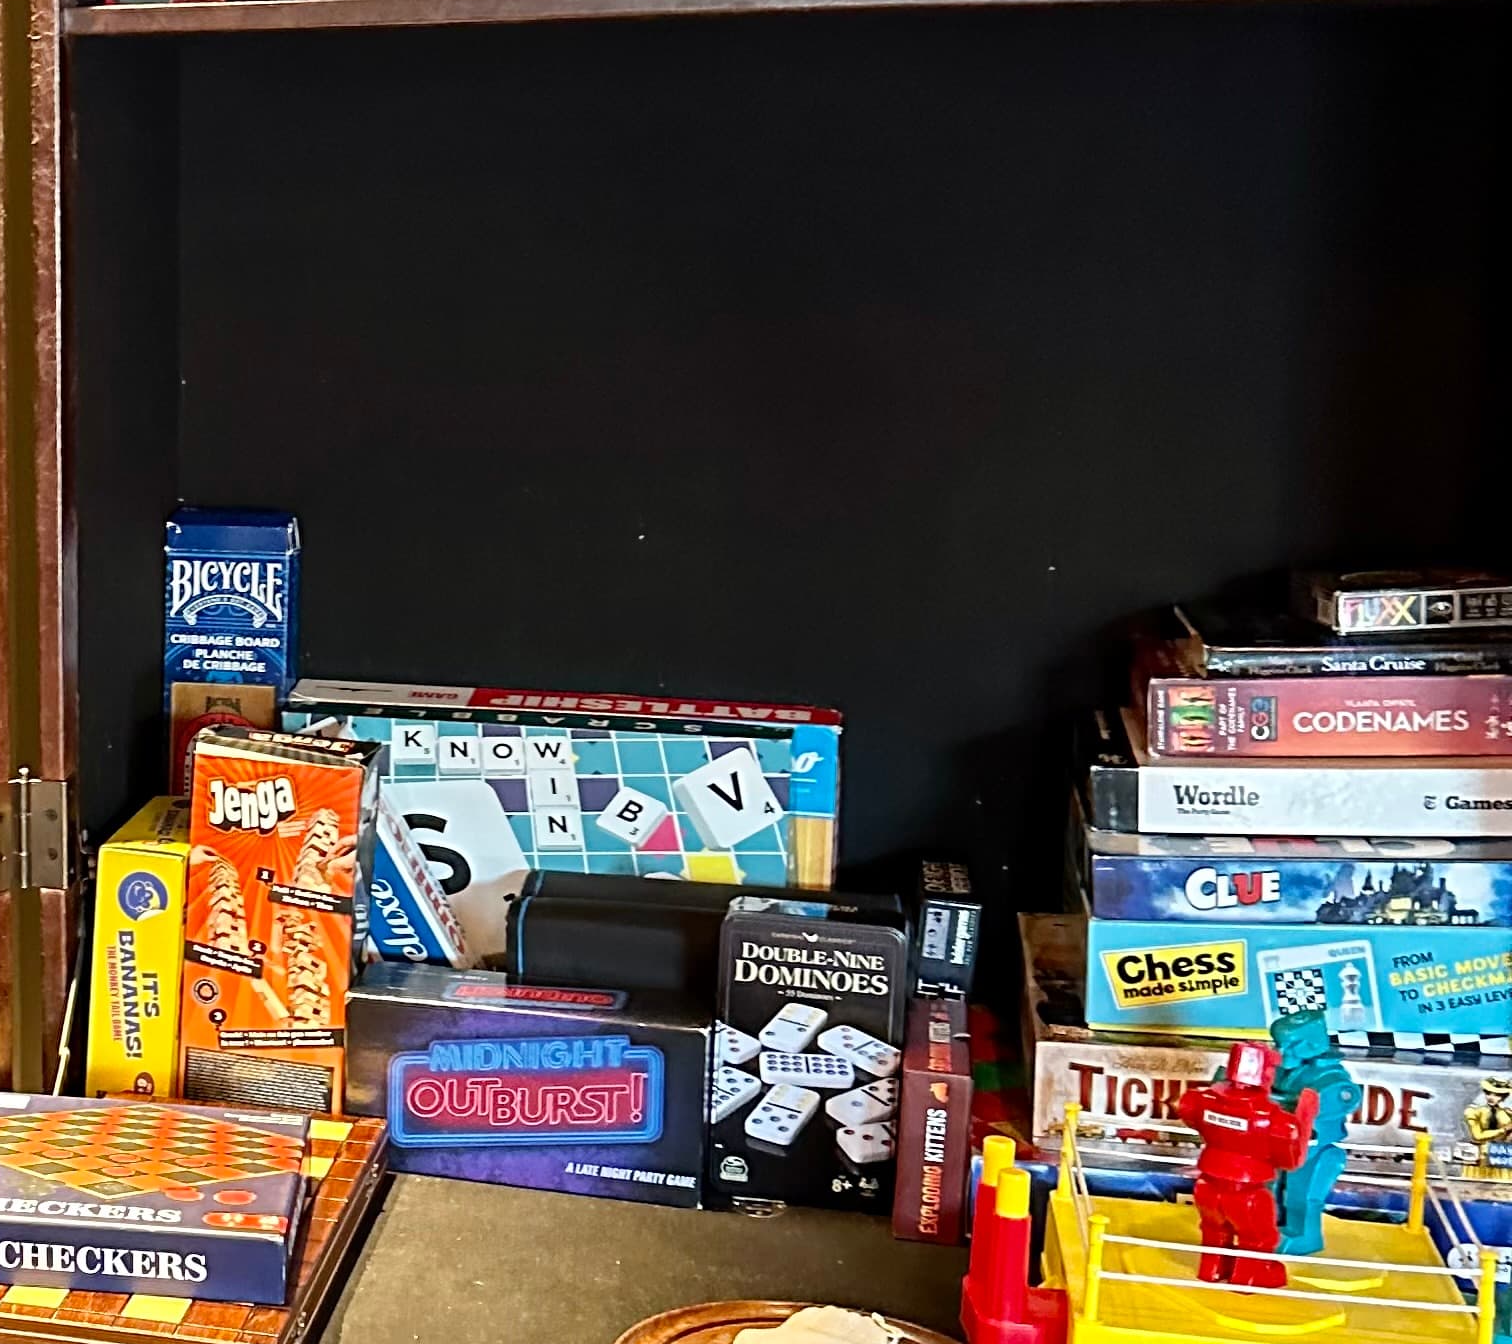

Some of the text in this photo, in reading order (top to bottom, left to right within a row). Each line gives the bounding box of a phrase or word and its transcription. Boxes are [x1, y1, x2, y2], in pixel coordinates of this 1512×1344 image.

[170, 559, 283, 623] BICYCLE
[1341, 595, 1420, 627] FLUXX
[170, 633, 281, 648] CRIBBAGE BOARD
[194, 648, 255, 661] PLANCHE
[183, 659, 267, 674] DE CRIBBAGE
[1320, 656, 1368, 673] Santa
[1368, 655, 1426, 673] Cruise
[362, 706, 702, 733] SCRABBLE
[489, 693, 814, 723] BATTLESHIP
[1292, 709, 1471, 733] CODENAMES
[247, 731, 356, 754] Jenga
[208, 776, 296, 832] Jenga
[1173, 785, 1260, 807] Wordle
[1445, 795, 1512, 810] Games
[1186, 866, 1281, 911] CLUE
[106, 945, 116, 961] THE
[741, 941, 886, 972] DOUBLE-NINE
[1392, 951, 1435, 969] FROM
[108, 961, 119, 994] MONKEY
[734, 958, 889, 996] DOMINOES
[1116, 950, 1237, 985] Chess
[1389, 950, 1512, 987] BASIC MOVE
[117, 929, 143, 1060] BANANAS!
[141, 971, 160, 1018] IT'S
[1122, 974, 1240, 999] made simple
[1398, 987, 1420, 1002] TO
[1418, 1001, 1434, 1015] IN
[1435, 998, 1447, 1012] 3
[1448, 995, 1483, 1011] EASY
[112, 1012, 123, 1042] GAME
[429, 1038, 629, 1072] MIDNIGHT
[406, 1071, 650, 1127] OUTBURST!
[565, 1162, 698, 1189] A LATE NIGHT PARTY GAME
[831, 1177, 854, 1193] 8+
[918, 1106, 948, 1236] EXPLODING KITTENS
